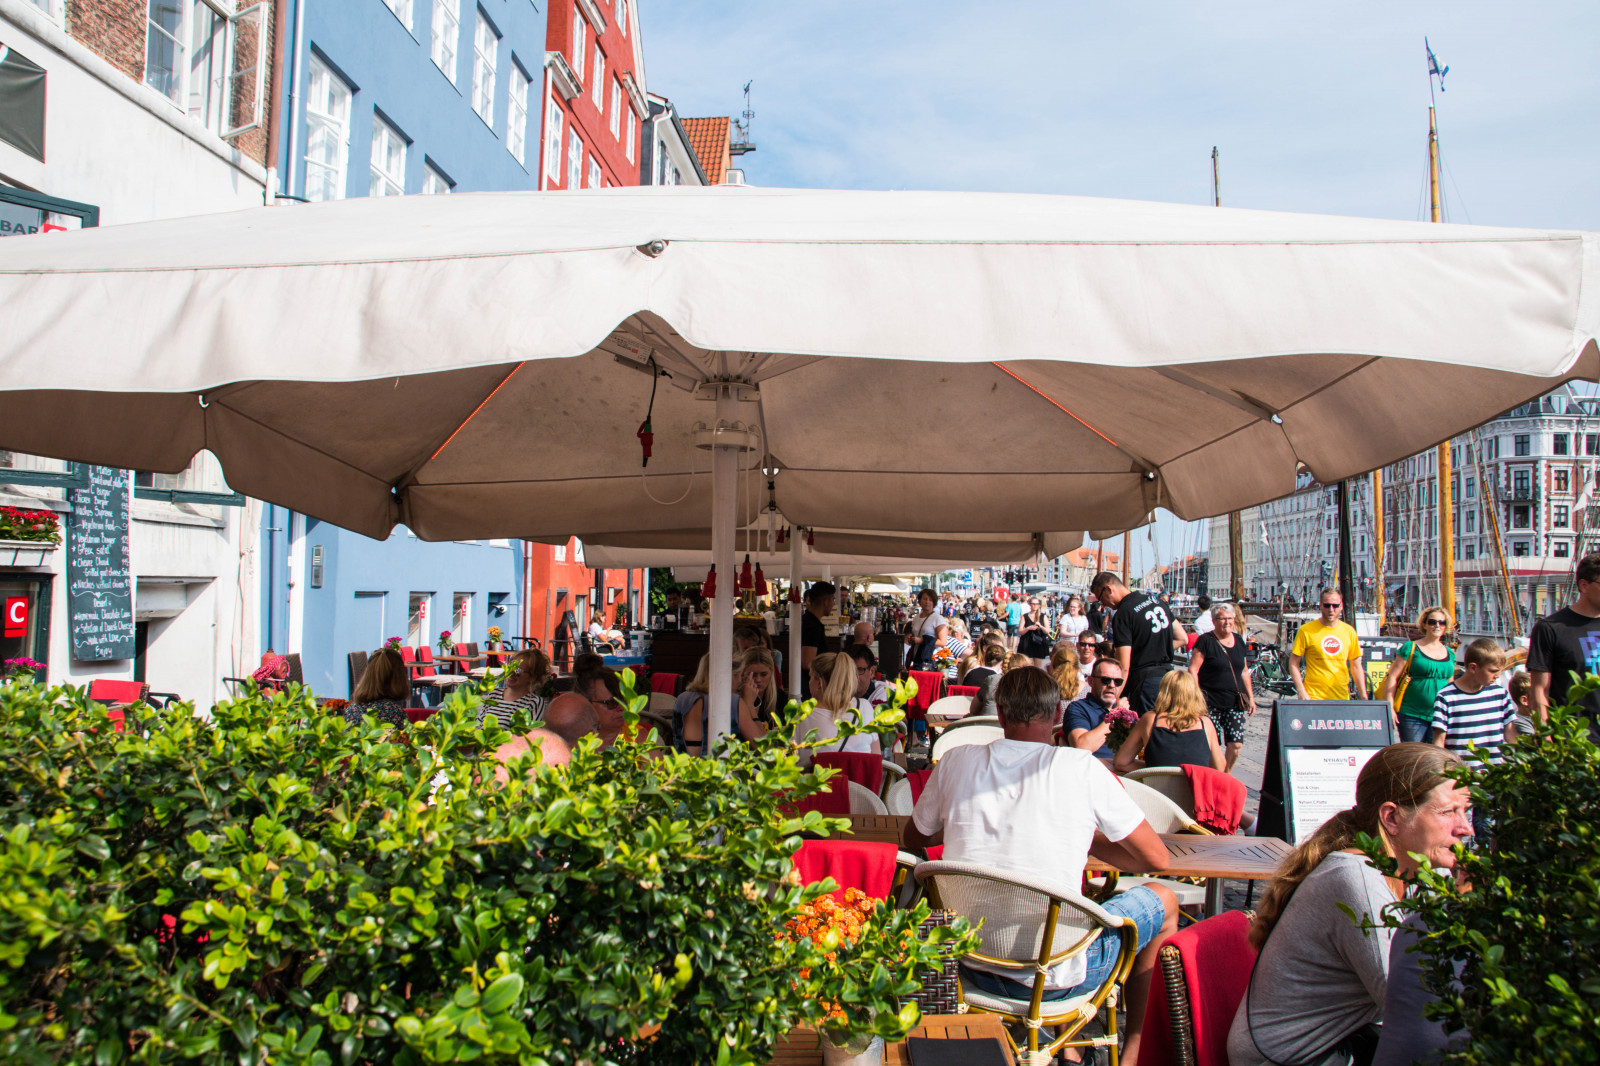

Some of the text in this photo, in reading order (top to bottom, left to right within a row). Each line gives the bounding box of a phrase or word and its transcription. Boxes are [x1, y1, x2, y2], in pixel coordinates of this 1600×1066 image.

[0, 220, 39, 235] BAR
[10, 602, 25, 623] C
[1144, 606, 1169, 633] 33
[1308, 719, 1382, 730] JACOBSEN
